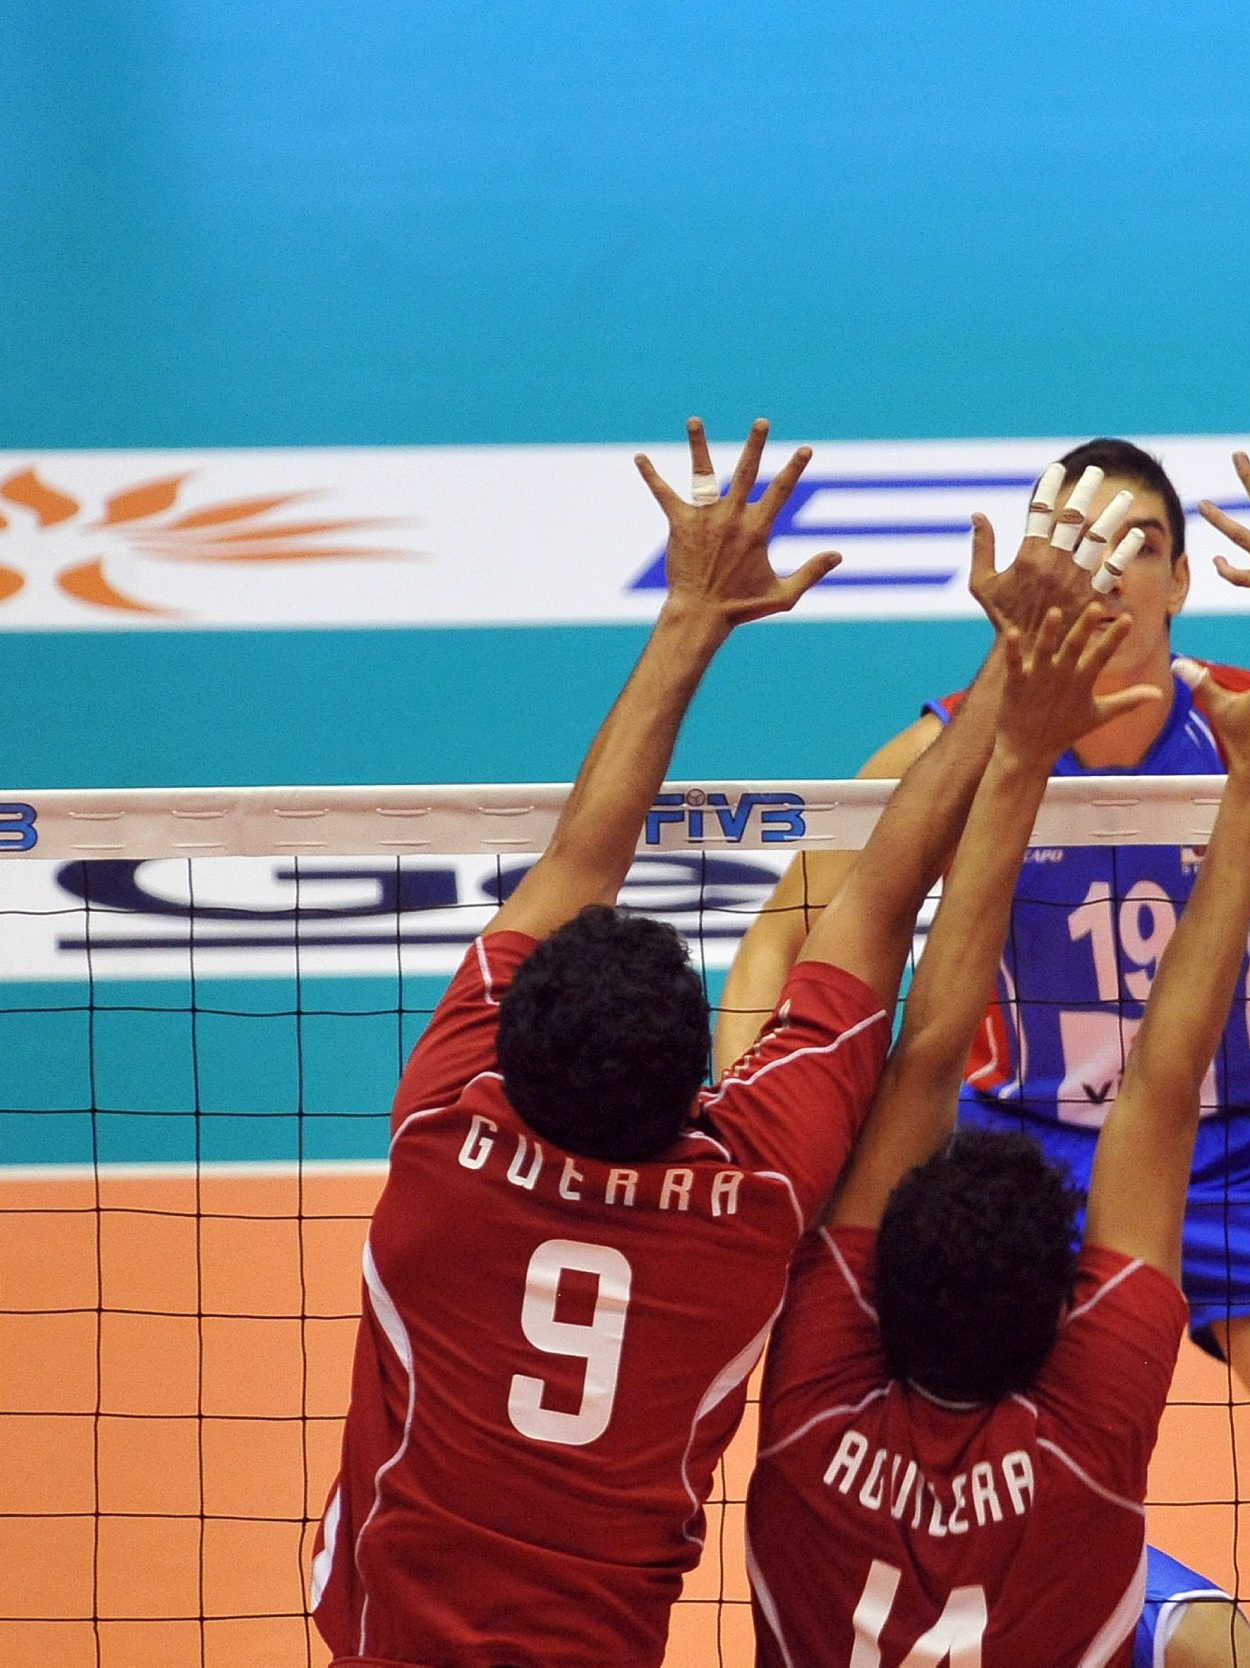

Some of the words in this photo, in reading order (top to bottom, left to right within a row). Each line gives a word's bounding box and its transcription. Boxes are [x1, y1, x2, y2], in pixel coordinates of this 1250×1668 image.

[1067, 880, 1177, 1005] 19
[457, 1114, 745, 1217] GUERRA
[507, 1239, 633, 1446] 9
[822, 1430, 1035, 1537] AGUILERA
